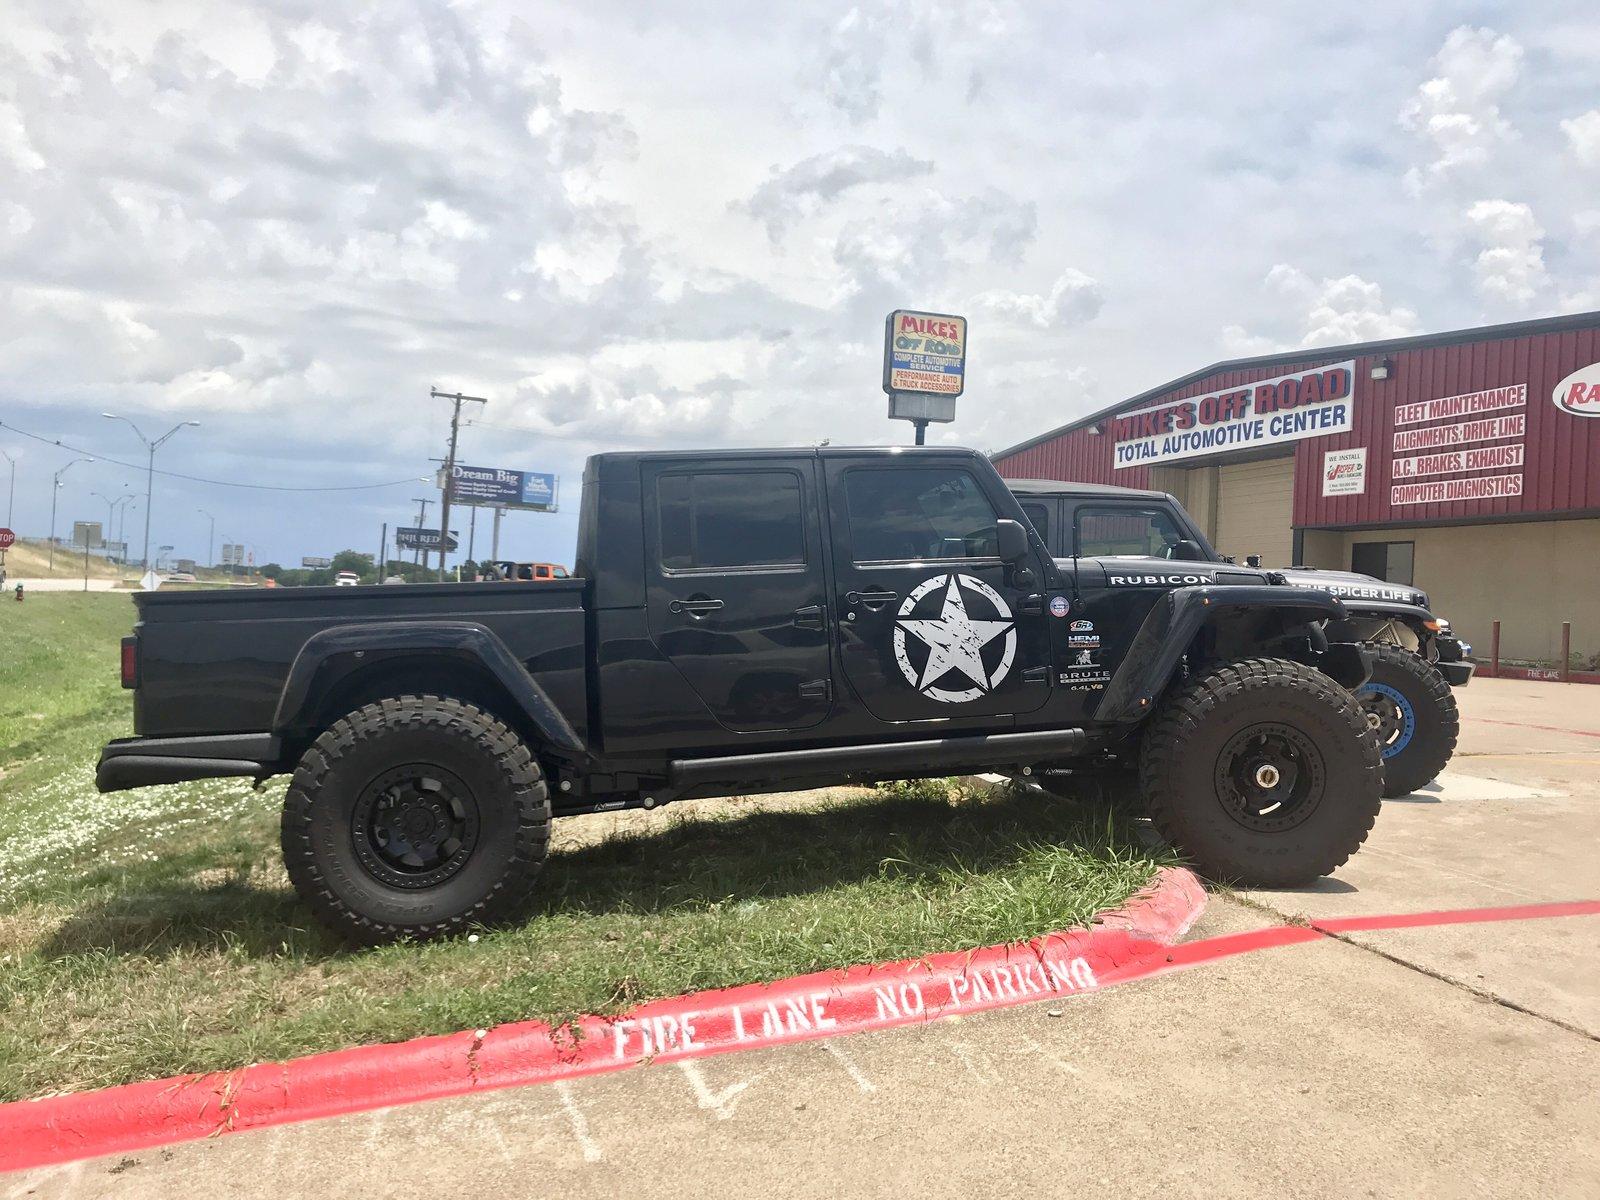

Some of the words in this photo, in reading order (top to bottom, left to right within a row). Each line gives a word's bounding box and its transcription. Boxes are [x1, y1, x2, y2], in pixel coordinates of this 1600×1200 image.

[901, 316, 958, 340] MIKE'S
[894, 352, 924, 364] COMPLETE
[925, 356, 961, 368] AUTOMOTIVE
[909, 362, 945, 372] SERVICE
[896, 370, 941, 383] PERFORMANCE
[899, 380, 919, 389] TRUCK
[920, 382, 960, 393] ACCESSORIES
[1112, 402, 1197, 442] MIKE'S
[1200, 389, 1252, 426] OFF
[1254, 368, 1352, 416] ROAD
[1395, 405, 1428, 424] FLEET
[1428, 385, 1526, 419] MAINTENANCE
[1117, 440, 1158, 463] TOTAL
[1161, 420, 1264, 456] AUTOMOTIVE
[1269, 404, 1346, 437] CENTER
[1462, 420, 1497, 437] DRIVE
[1499, 415, 1524, 436] LINE
[1465, 445, 1523, 470] EXHAUST
[452, 466, 493, 481] Dream
[496, 469, 519, 486] Big
[1392, 483, 1445, 504] COMPUTER
[1446, 475, 1521, 500] DIAGNOSTICS
[0, 533, 14, 543] TOP
[1110, 575, 1214, 585] RUBICON
[1329, 585, 1379, 599] SPICER
[1381, 590, 1411, 601] LIFE
[1059, 671, 1110, 679] BRUTE
[615, 1010, 705, 1059] FIRE
[732, 992, 836, 1042] LANE
[873, 982, 924, 1021] NO
[948, 956, 1098, 1010] PARKING
